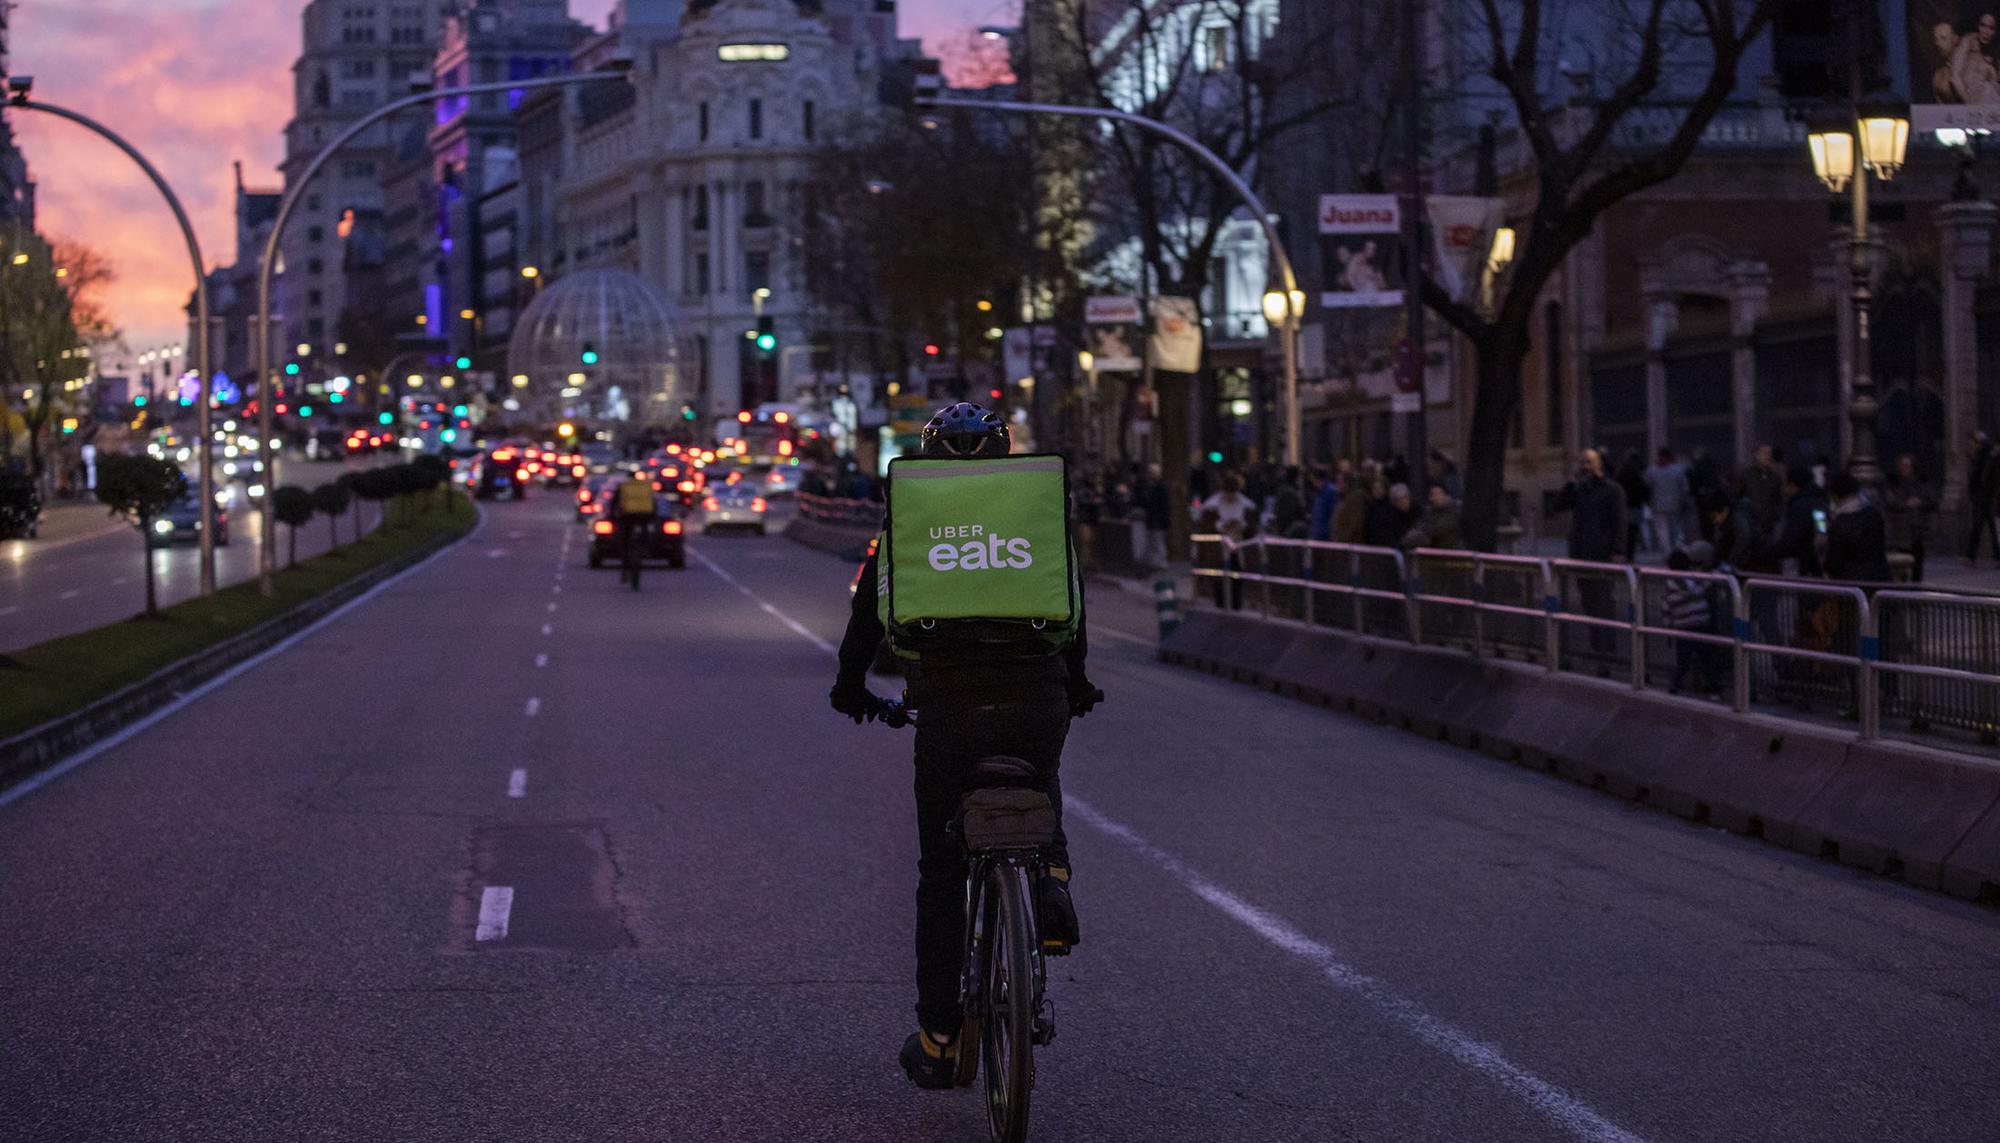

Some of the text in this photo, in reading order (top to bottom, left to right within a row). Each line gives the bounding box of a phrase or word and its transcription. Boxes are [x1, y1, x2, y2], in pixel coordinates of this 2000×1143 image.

[1324, 206, 1393, 224] Juana
[929, 524, 983, 539] UBER
[928, 533, 1032, 571] eats
